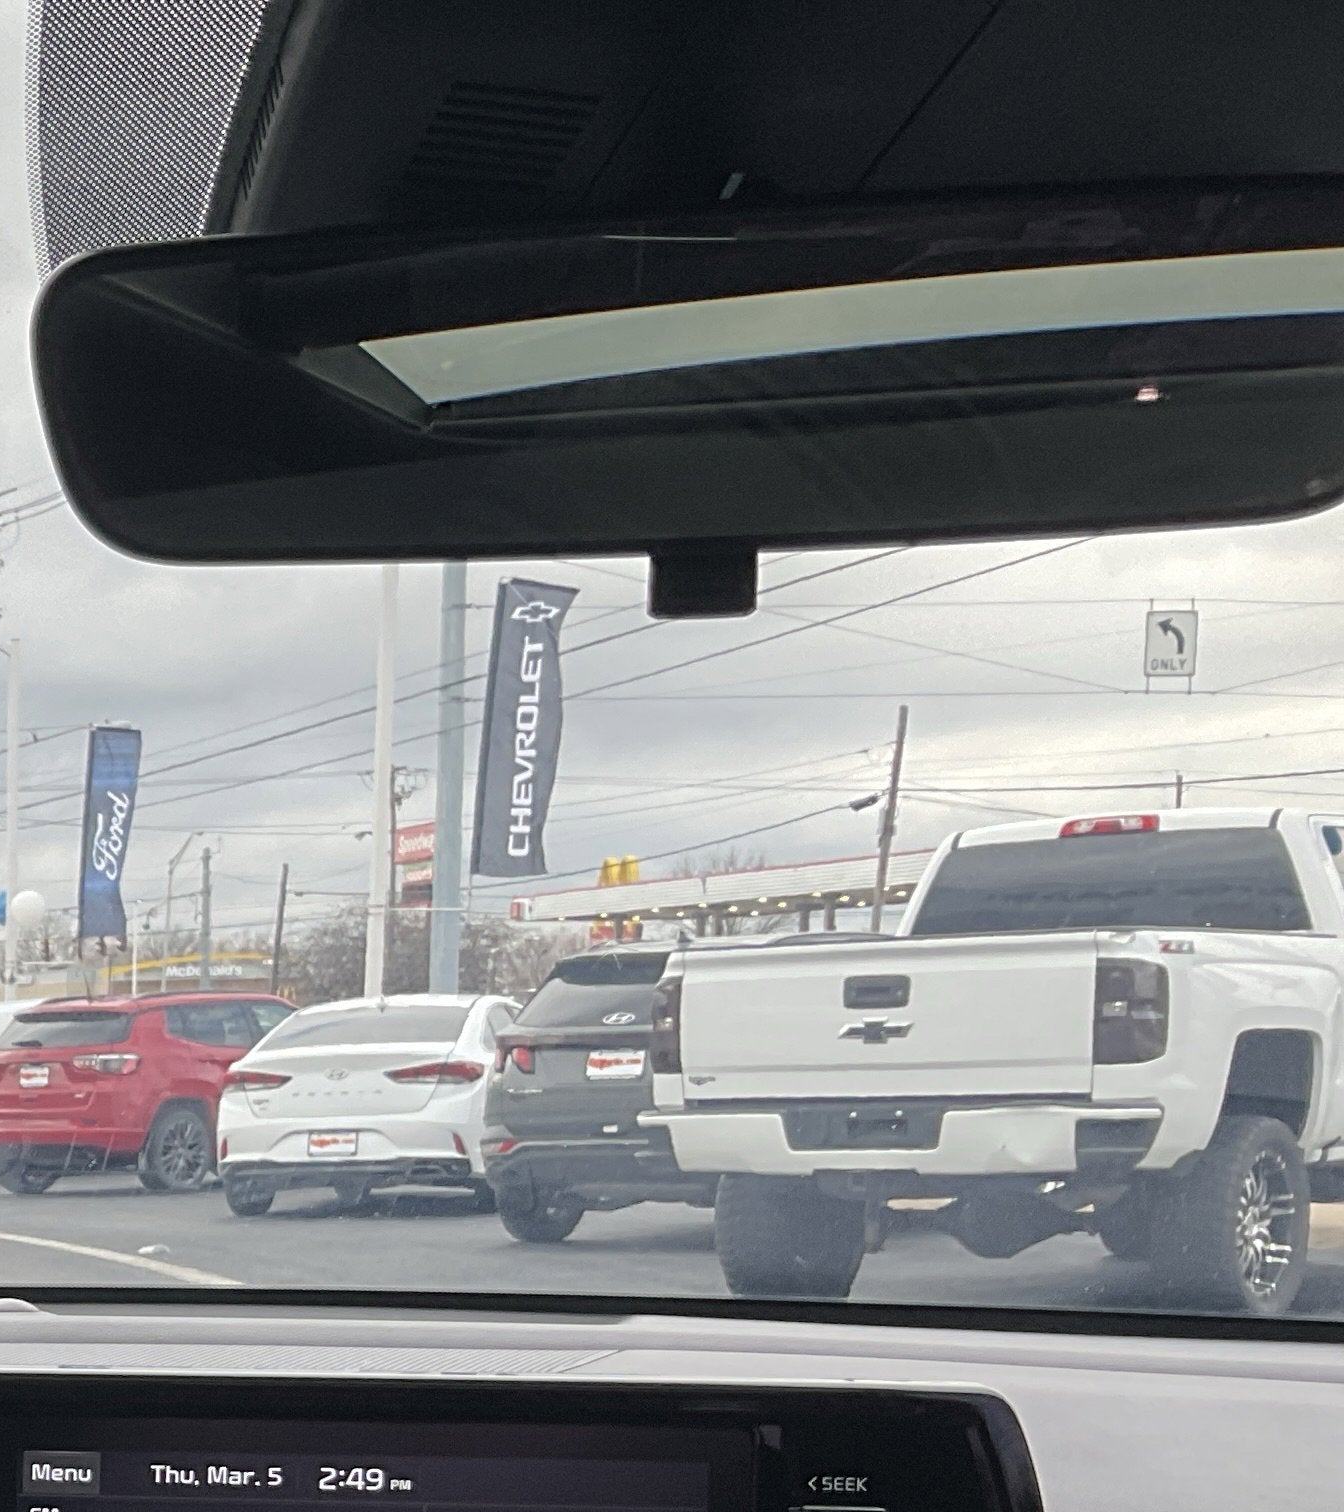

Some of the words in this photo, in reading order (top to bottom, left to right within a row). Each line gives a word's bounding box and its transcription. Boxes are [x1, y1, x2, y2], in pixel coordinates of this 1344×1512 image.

[1151, 658, 1187, 671] ONLY
[507, 636, 544, 857] CHEVROLET
[93, 790, 129, 880] Ford
[31, 1464, 91, 1482] Menu
[151, 1465, 199, 1486] Thu,
[208, 1466, 260, 1486] Mar.
[267, 1468, 282, 1486] 5
[319, 1468, 383, 1490] 2:49
[390, 1479, 411, 1490] PM
